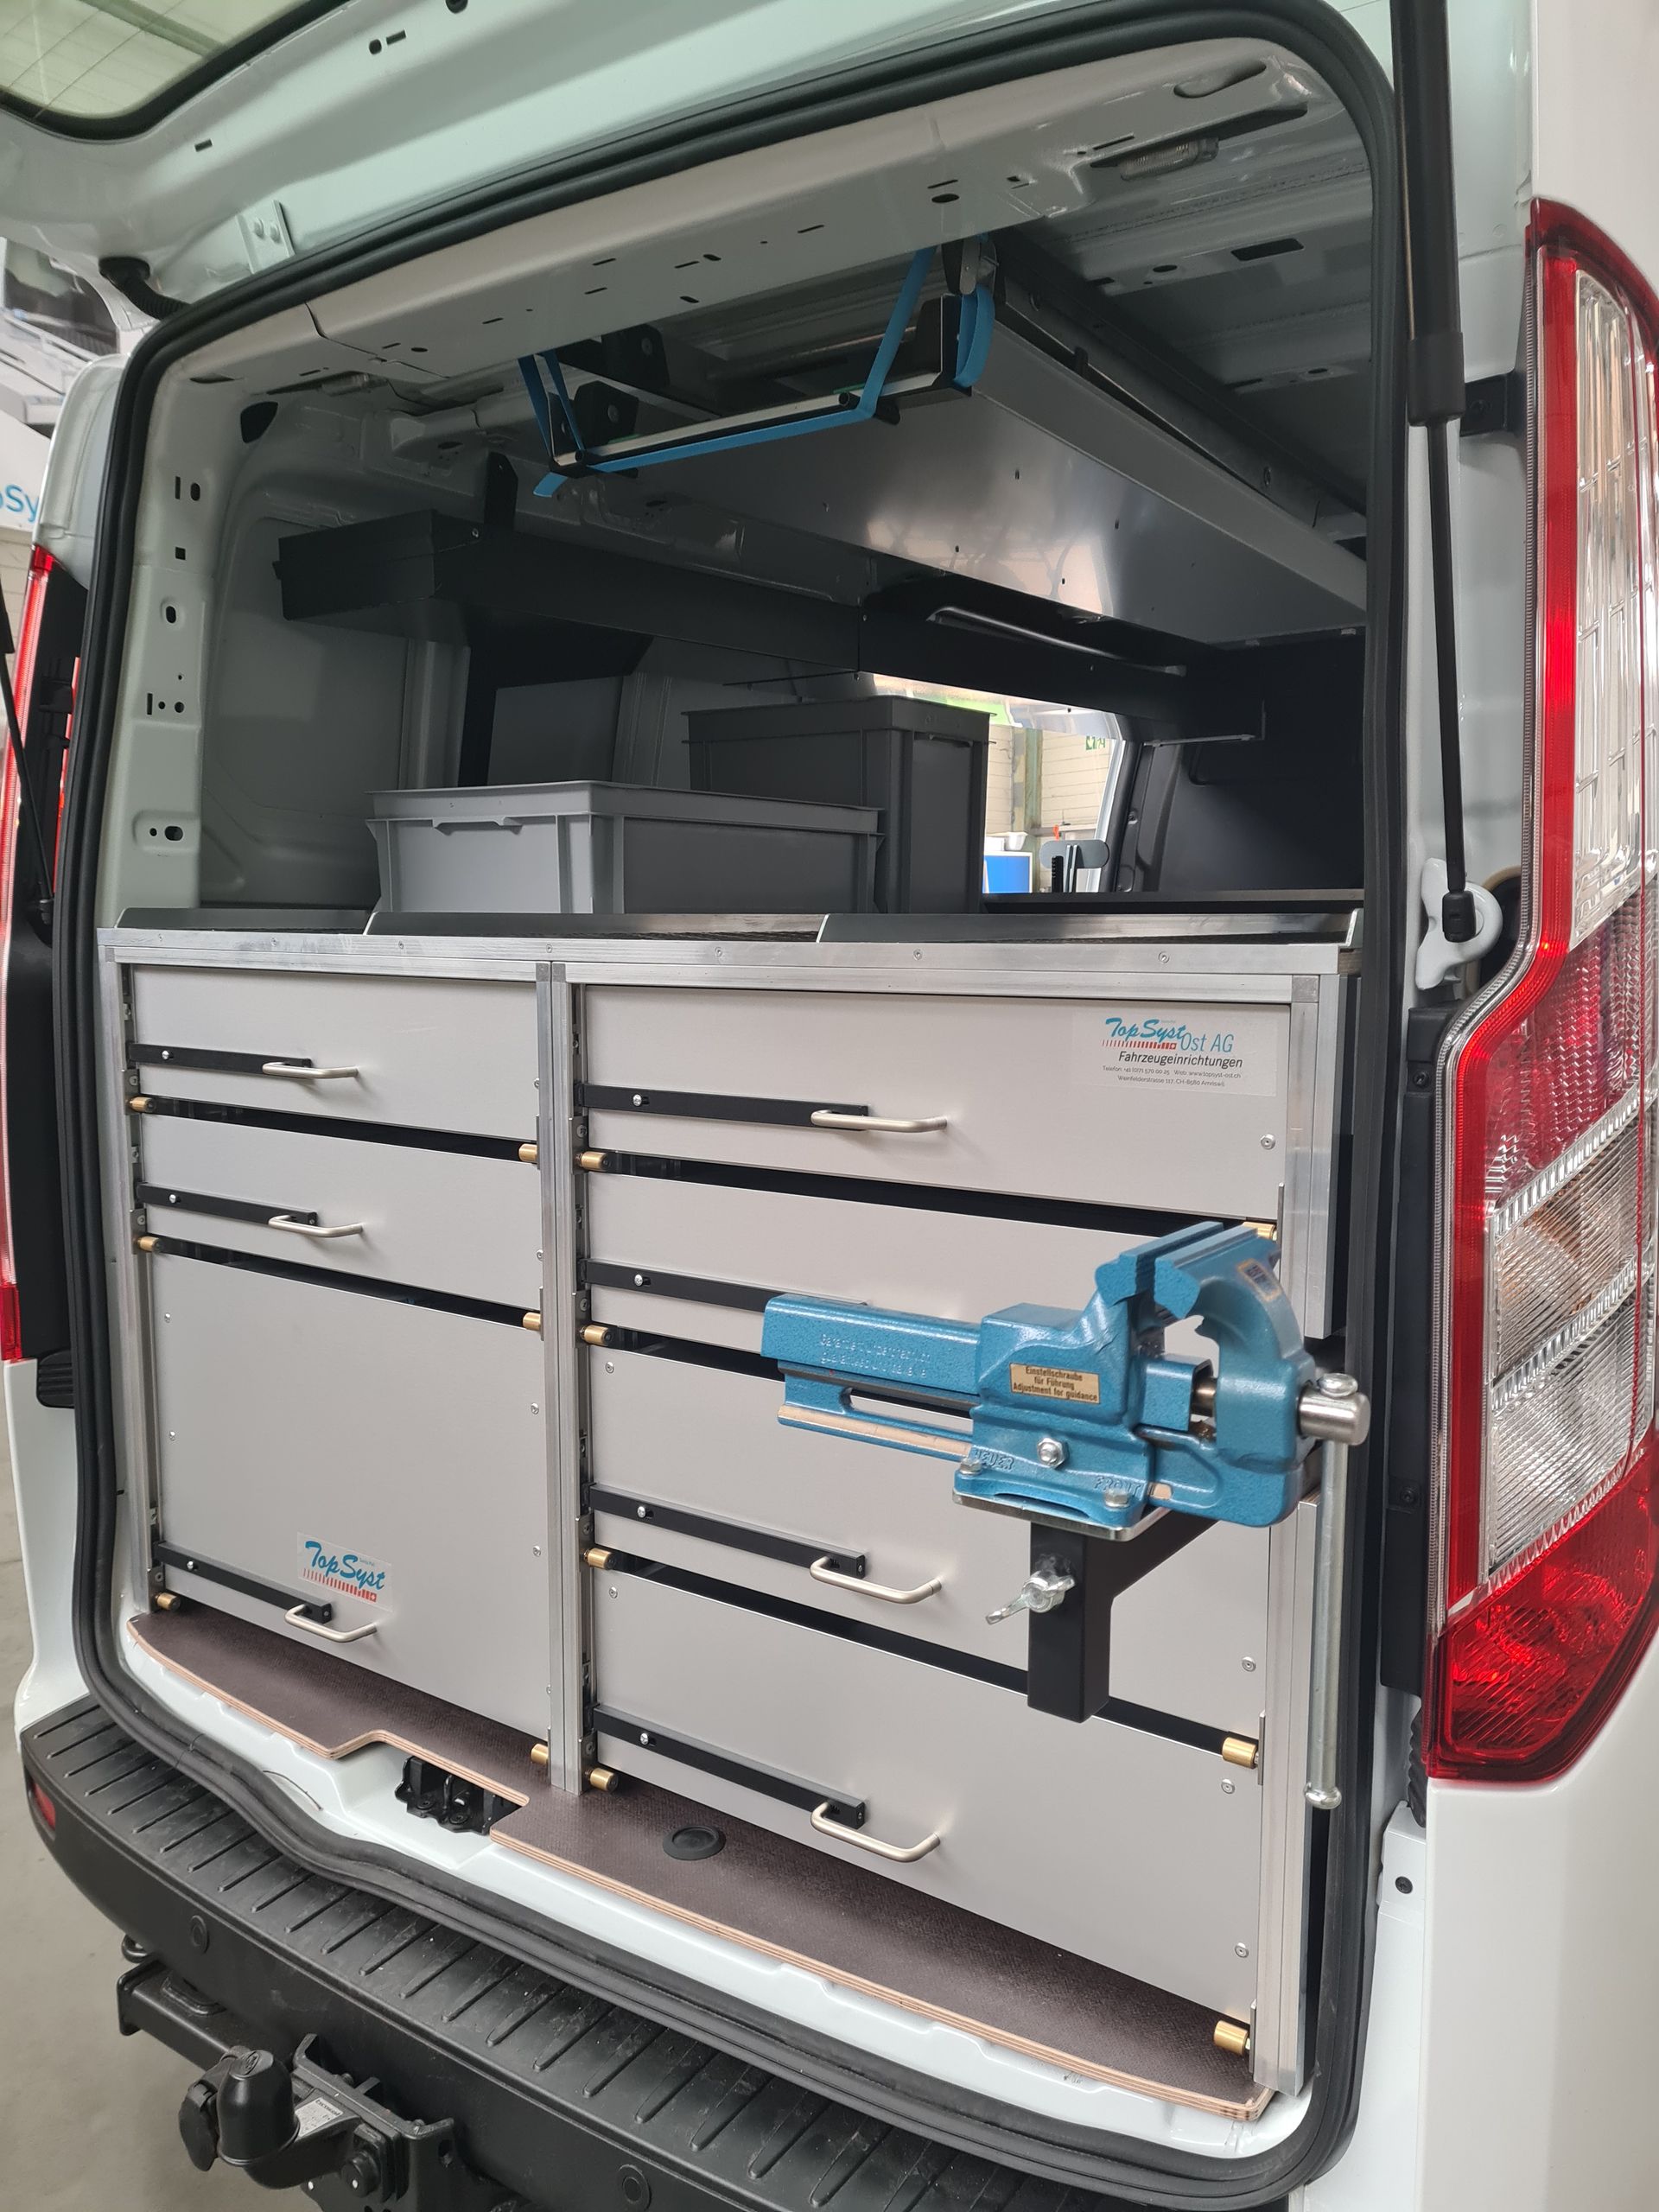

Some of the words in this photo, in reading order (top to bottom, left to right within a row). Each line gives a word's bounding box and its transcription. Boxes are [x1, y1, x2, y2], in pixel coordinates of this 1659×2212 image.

[1105, 1017, 1187, 1042] TopSyst
[1180, 1032, 1207, 1052] Ost
[1210, 1033, 1235, 1052] AG
[1118, 1051, 1243, 1069] Fahrzeugeinrichtungen
[1026, 1366, 1083, 1382] Einstellschraube
[1046, 1377, 1075, 1390] Führung
[1013, 1382, 1052, 1395] Adjustment
[1053, 1388, 1064, 1396] for
[1066, 1390, 1098, 1402] guidance
[304, 1541, 385, 1590] TopSyst
